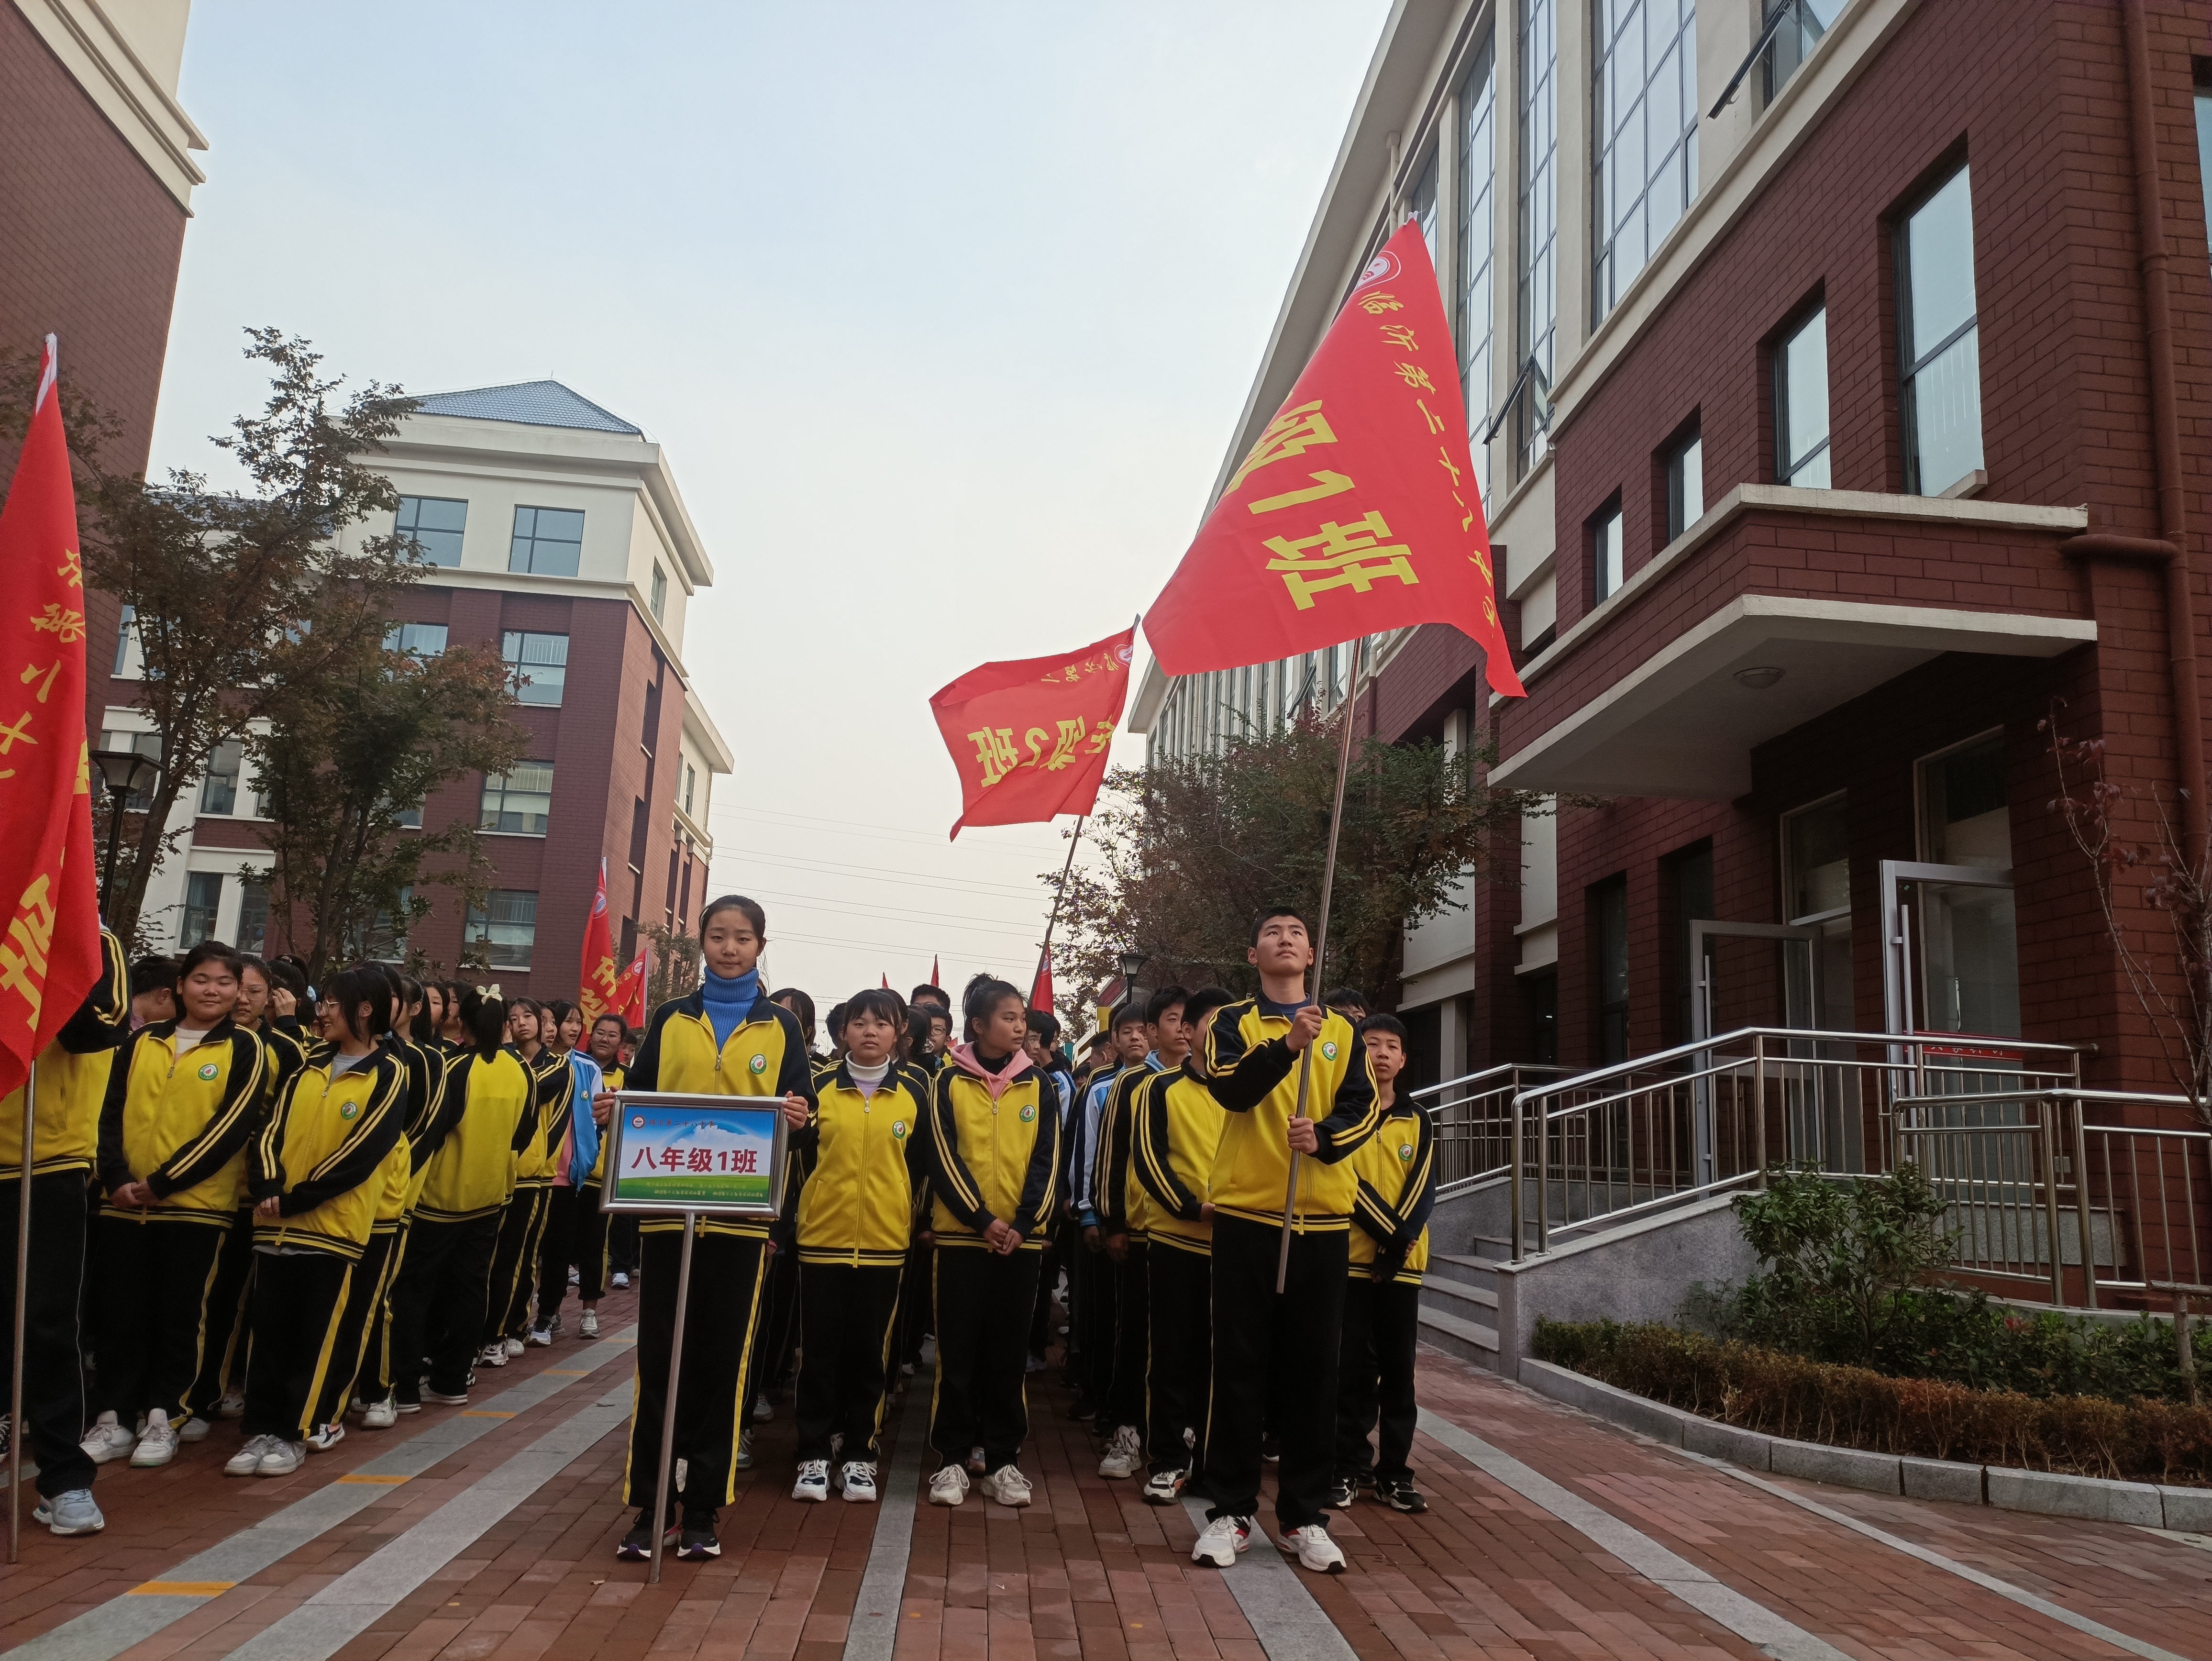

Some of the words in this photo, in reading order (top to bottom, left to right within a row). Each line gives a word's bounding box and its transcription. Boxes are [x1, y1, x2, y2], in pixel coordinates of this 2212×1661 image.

[648, 1118, 716, 1130] 临沂第二十八中学
[631, 1146, 758, 1174] 八年级1班
